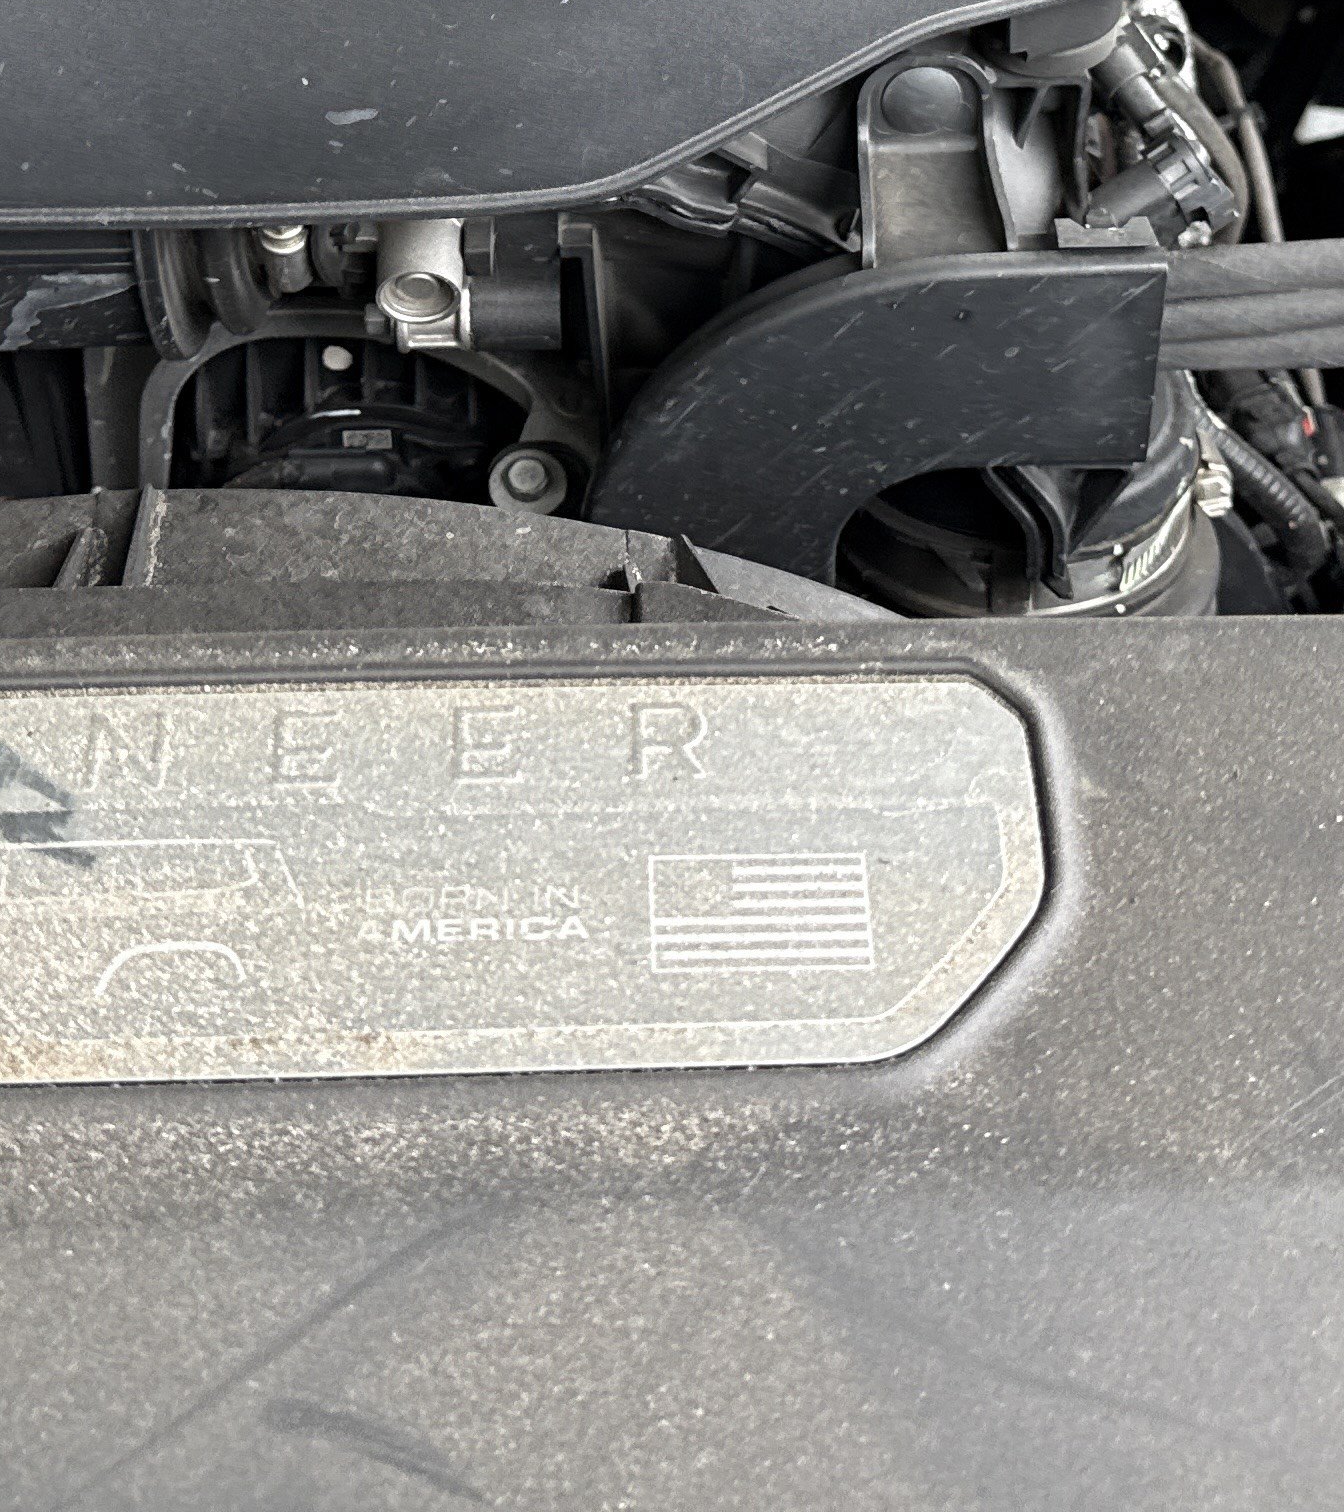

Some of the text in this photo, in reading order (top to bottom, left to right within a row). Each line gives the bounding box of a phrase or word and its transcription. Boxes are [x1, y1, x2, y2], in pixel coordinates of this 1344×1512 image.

[364, 884, 580, 913] BORN IN
[357, 915, 590, 943] AMERICA
